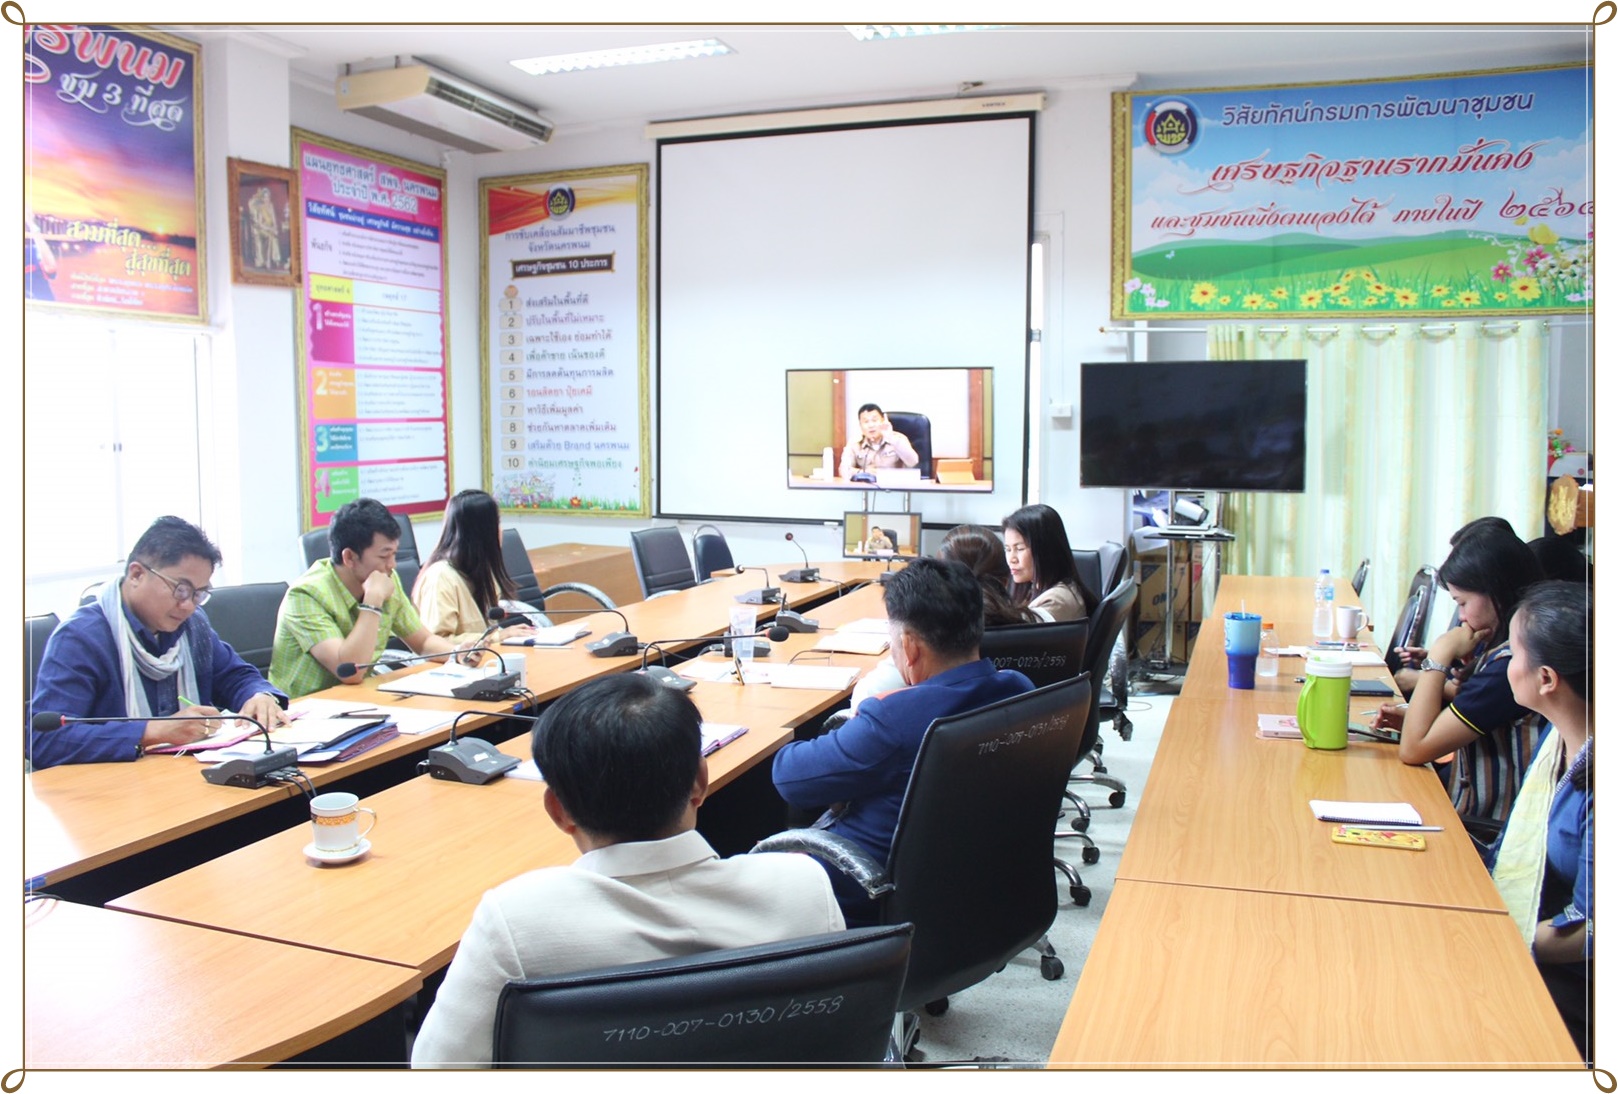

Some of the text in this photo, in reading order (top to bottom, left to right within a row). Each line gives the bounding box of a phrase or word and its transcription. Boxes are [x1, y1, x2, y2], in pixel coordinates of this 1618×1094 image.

[102, 83, 123, 105] 3
[1222, 92, 1534, 126] วิสัยทัศน์กรมการพัฒนาชุมชน
[304, 154, 375, 183] แผนยุทธศาสตร์
[1180, 138, 1550, 194] เศรษฐกิจฐานรากมั่นคง
[333, 180, 369, 200] ประจำปี
[1151, 195, 1391, 239] และชุมชนพึ่งตนเองได้
[1392, 195, 1484, 223] ภายในปี
[528, 241, 591, 253] จังหวัดนครพนม
[515, 258, 608, 274] เศรษฐกิจชุมชน 10 ประการ
[508, 300, 514, 309] 1
[508, 317, 515, 327] 2
[508, 334, 515, 344] 3
[508, 353, 515, 362] 4
[508, 370, 516, 381] 5
[509, 388, 516, 398] 6
[509, 405, 516, 416] 7
[509, 422, 517, 433] 8
[315, 425, 329, 452] 3
[510, 439, 517, 450] 9
[564, 441, 592, 450] Brand
[508, 458, 520, 468] 10
[603, 994, 845, 1042] 7110-007-0130/2558
